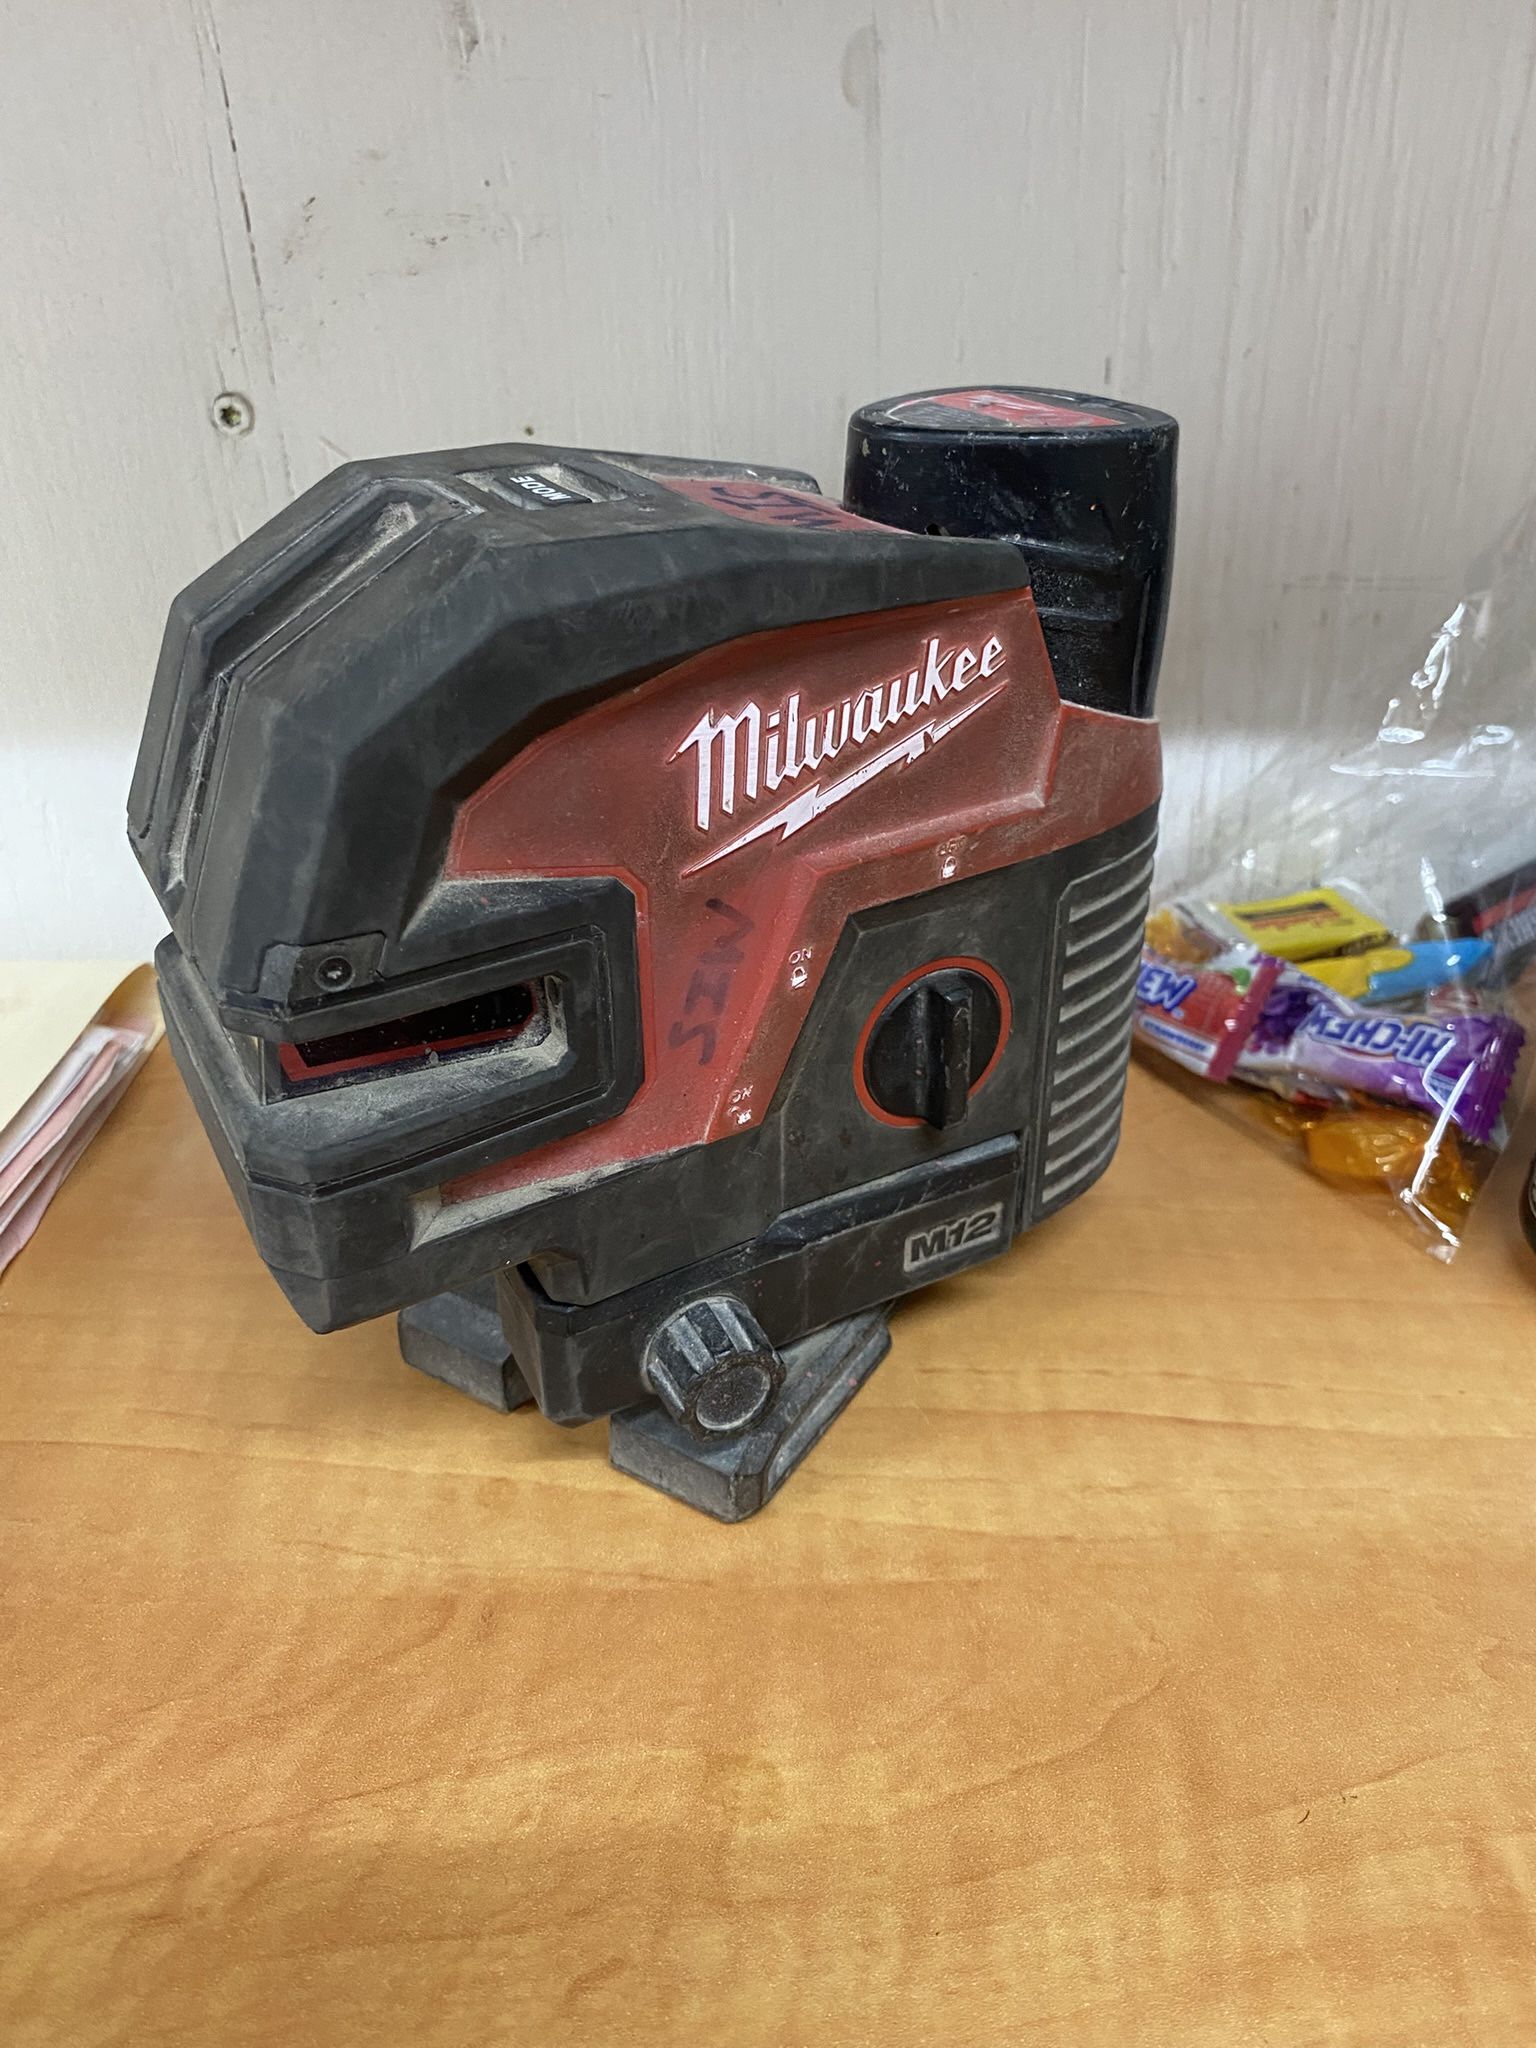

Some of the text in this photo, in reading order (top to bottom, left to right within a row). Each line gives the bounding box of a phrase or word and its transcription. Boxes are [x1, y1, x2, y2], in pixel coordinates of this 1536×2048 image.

[510, 475, 571, 500] MODE
[666, 633, 1007, 832] Milwaukee
[789, 946, 813, 964] ON
[1298, 1003, 1456, 1068] HI-CHEW
[728, 1084, 753, 1104] ON
[910, 1211, 997, 1263] M12
